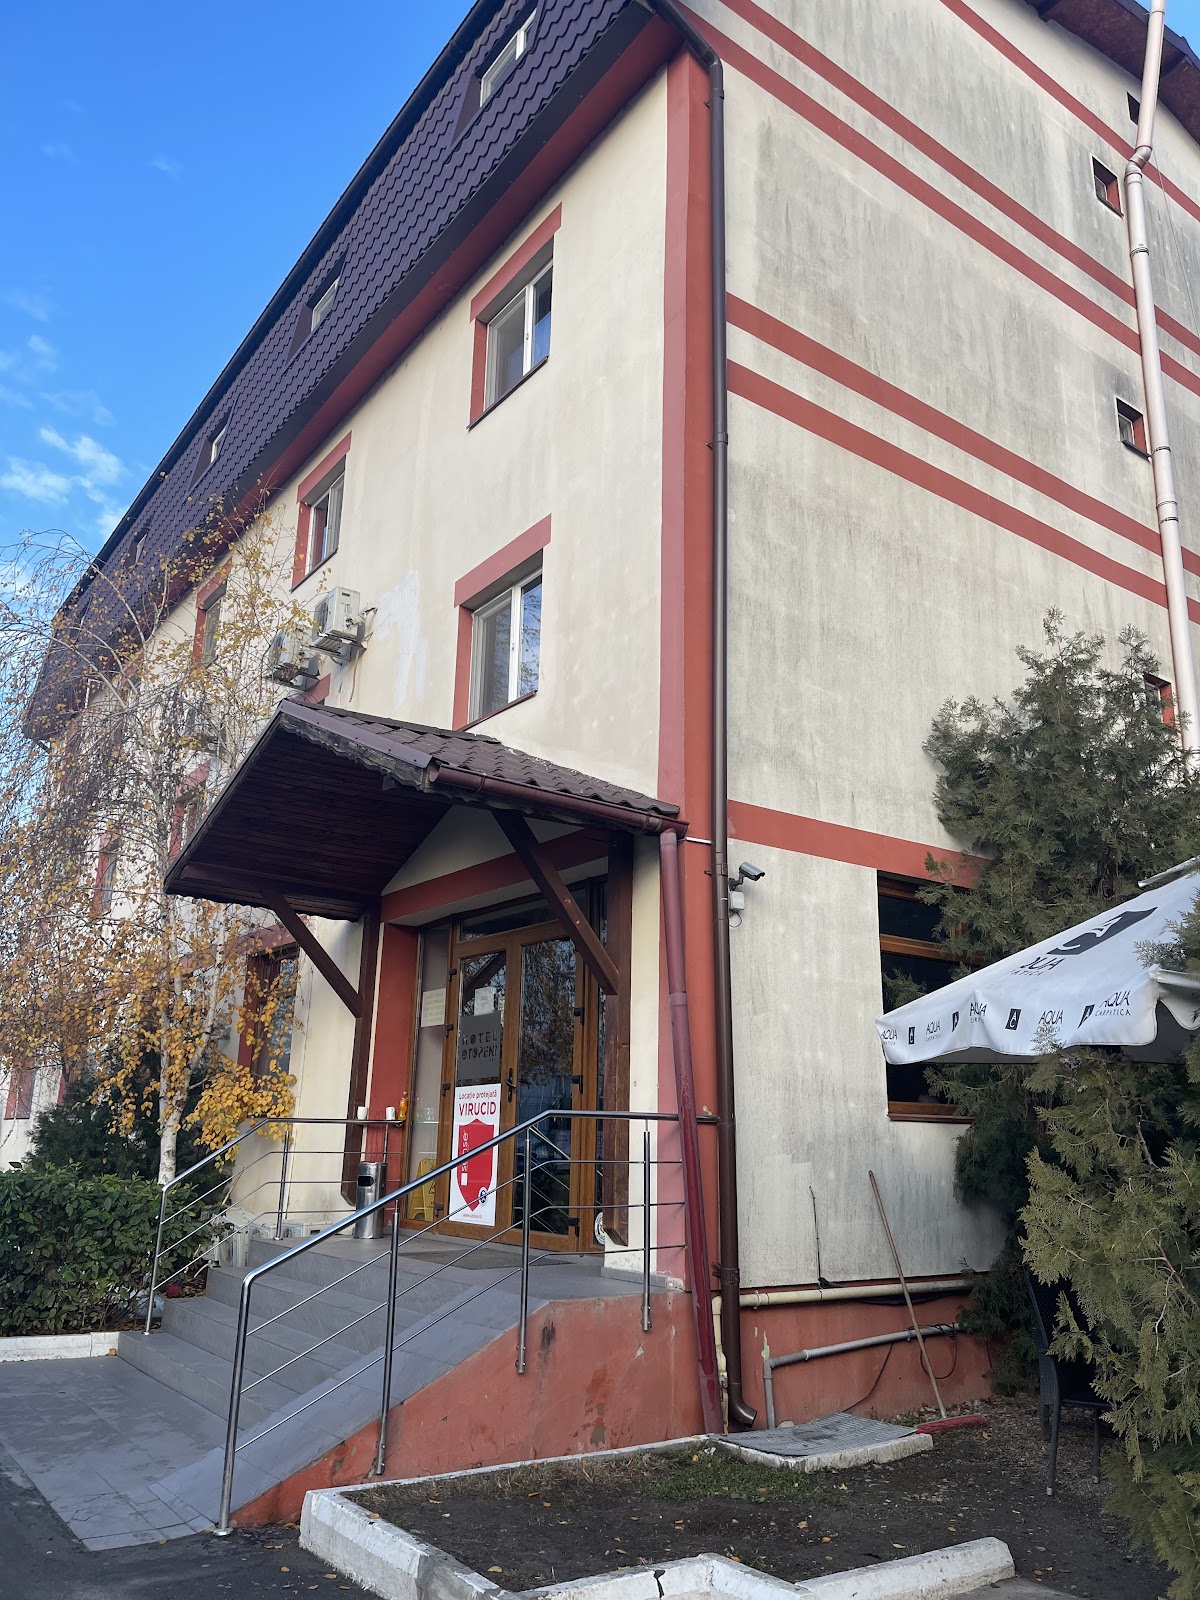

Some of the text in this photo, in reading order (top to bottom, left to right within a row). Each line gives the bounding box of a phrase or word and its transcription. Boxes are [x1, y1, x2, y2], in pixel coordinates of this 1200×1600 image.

[1099, 990, 1131, 1008] AQUA
[1038, 1010, 1064, 1025] AQUA
[1095, 1008, 1131, 1017] CARPATICA
[925, 1020, 941, 1035] AQUA
[462, 1030, 498, 1046] HOTEL
[461, 1045, 498, 1060] OTOPENI
[458, 1101, 497, 1116] VIRUCID
